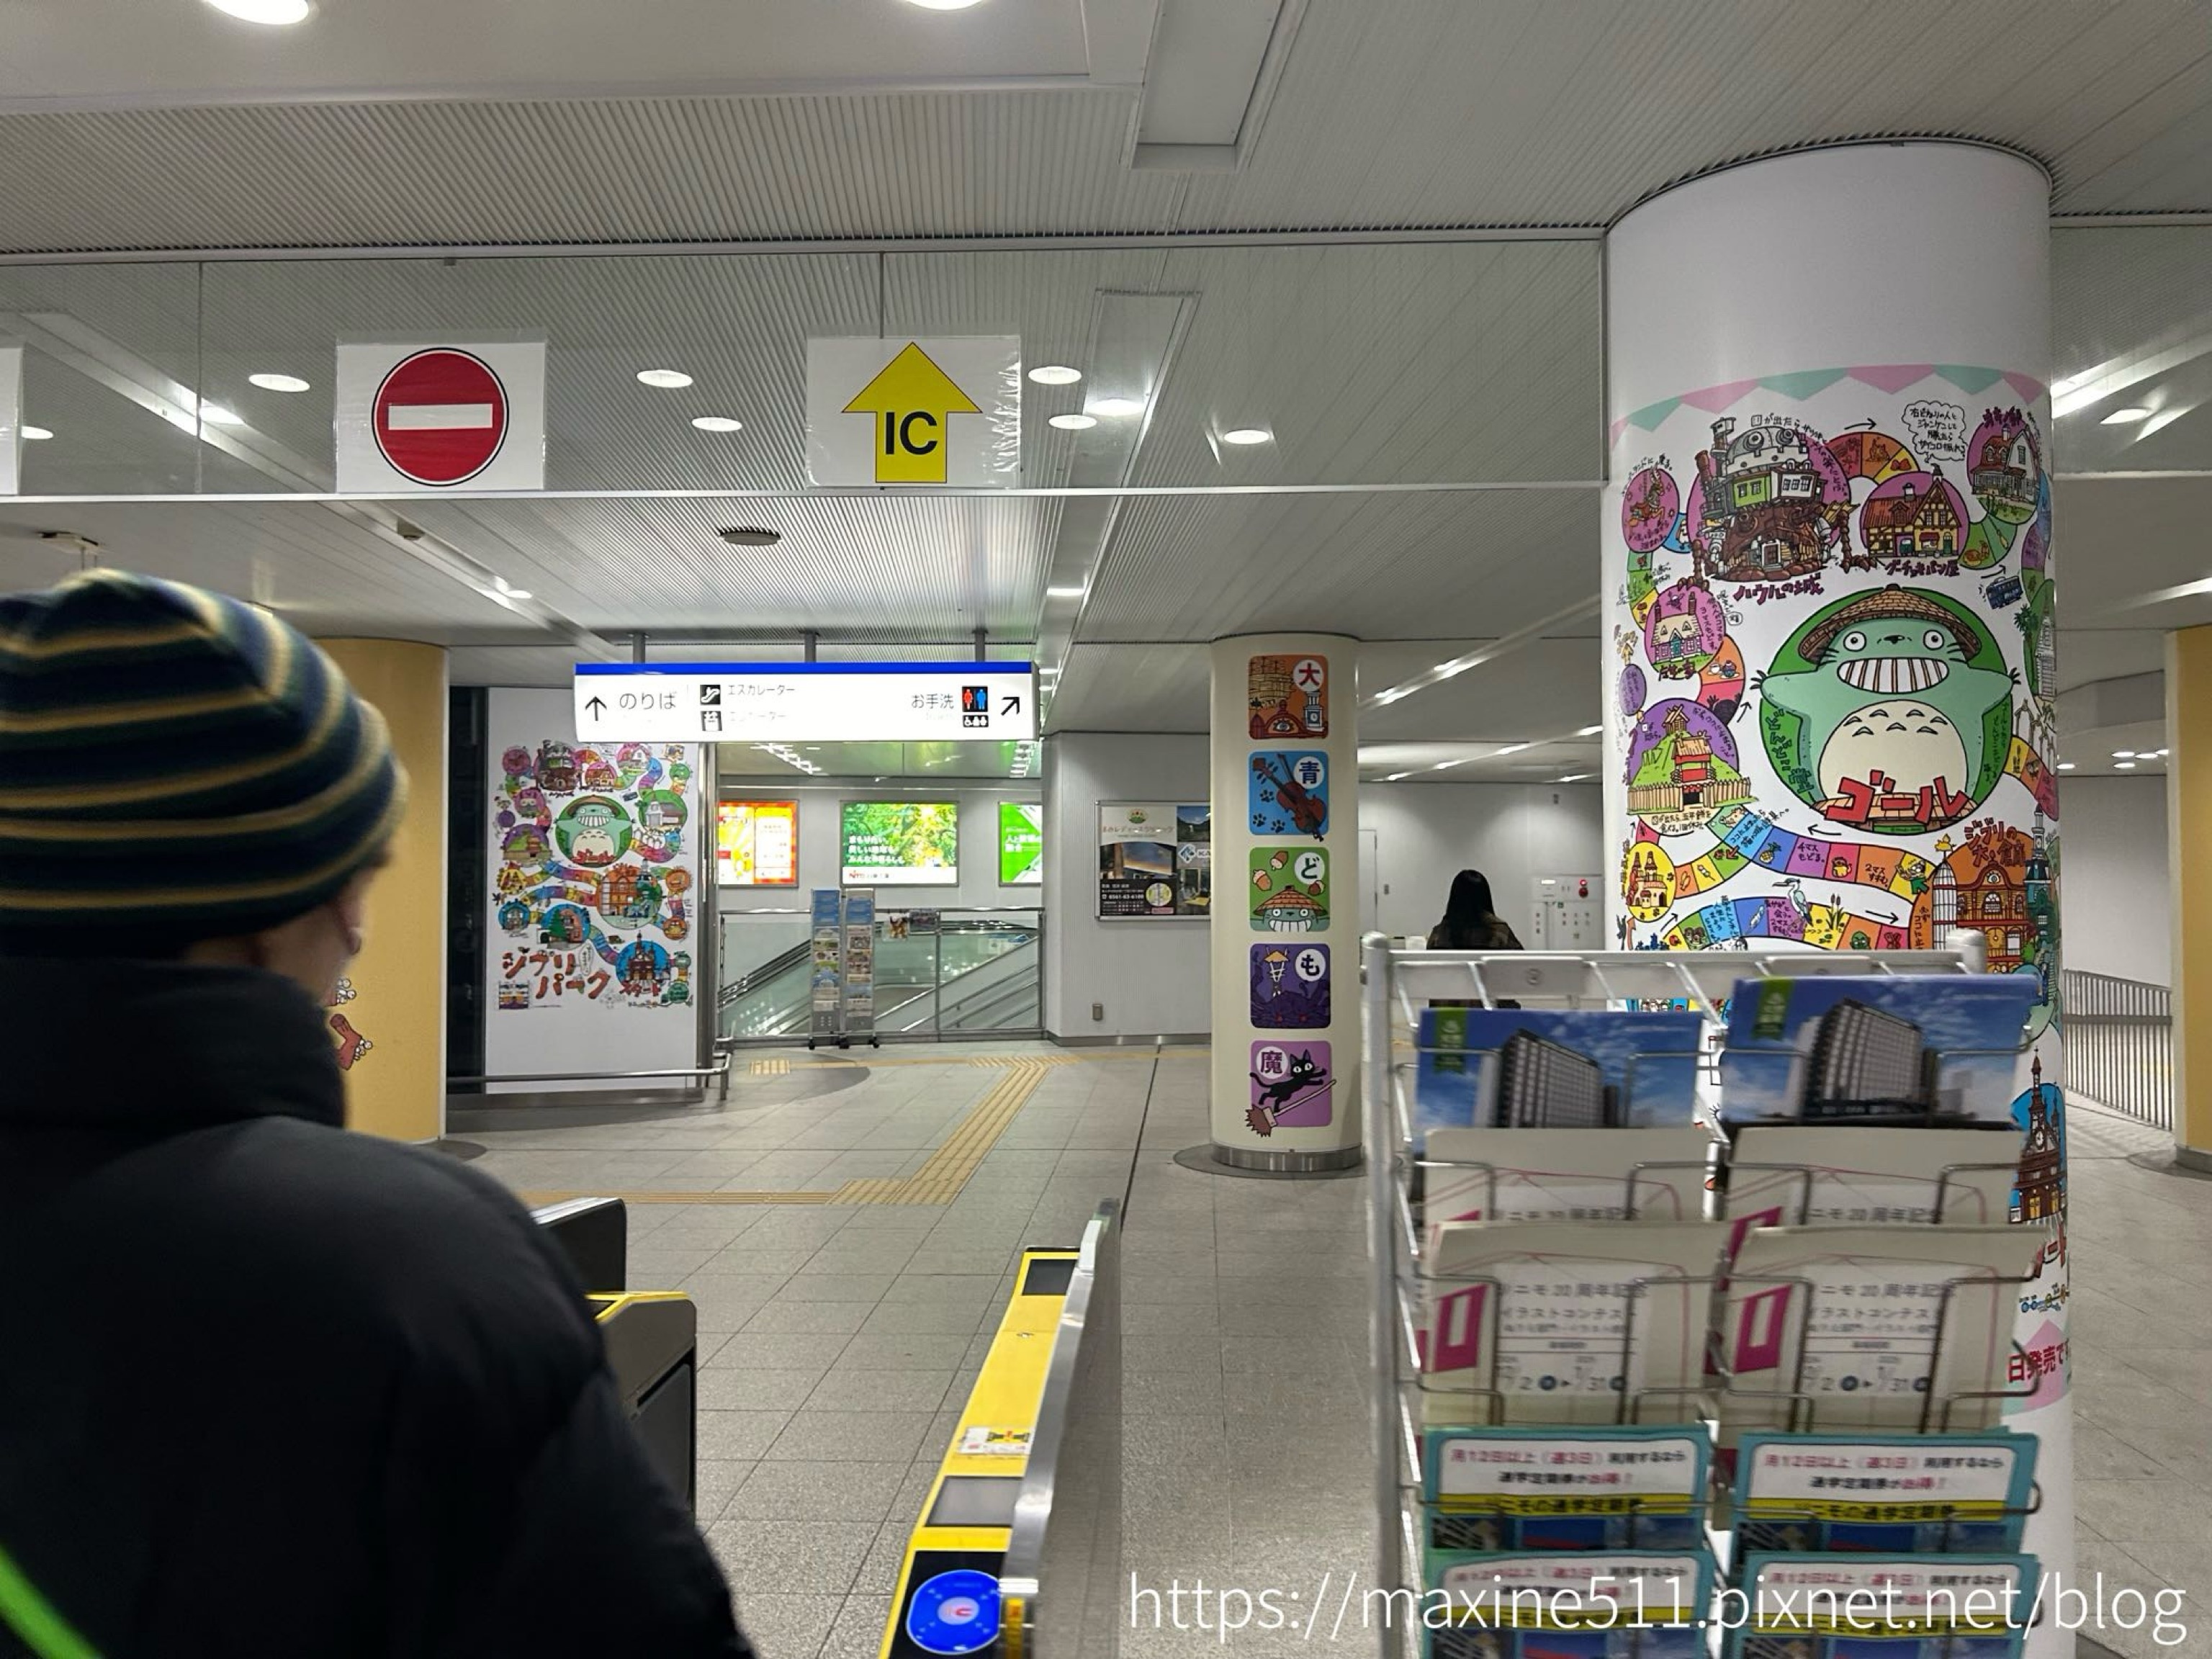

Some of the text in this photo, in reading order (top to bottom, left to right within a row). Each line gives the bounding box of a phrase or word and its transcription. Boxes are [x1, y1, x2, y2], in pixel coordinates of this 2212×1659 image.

[884, 409, 938, 455] IC
[1732, 572, 1825, 605] ハウルの城
[1298, 662, 1321, 686] 大
[619, 691, 677, 710] のりば
[728, 684, 796, 696] エスカレーター
[911, 693, 955, 710] お手洗
[1298, 760, 1321, 784] 青
[1823, 768, 1971, 824] ゴール
[1300, 856, 1321, 879] ど
[502, 950, 575, 979] ジブリ
[1300, 954, 1321, 976] も
[535, 970, 611, 999] パーク
[1259, 1050, 1282, 1074] 魔
[1501, 1307, 1636, 1321] イラストコンテス
[1812, 1306, 1933, 1321] ラストコンテス
